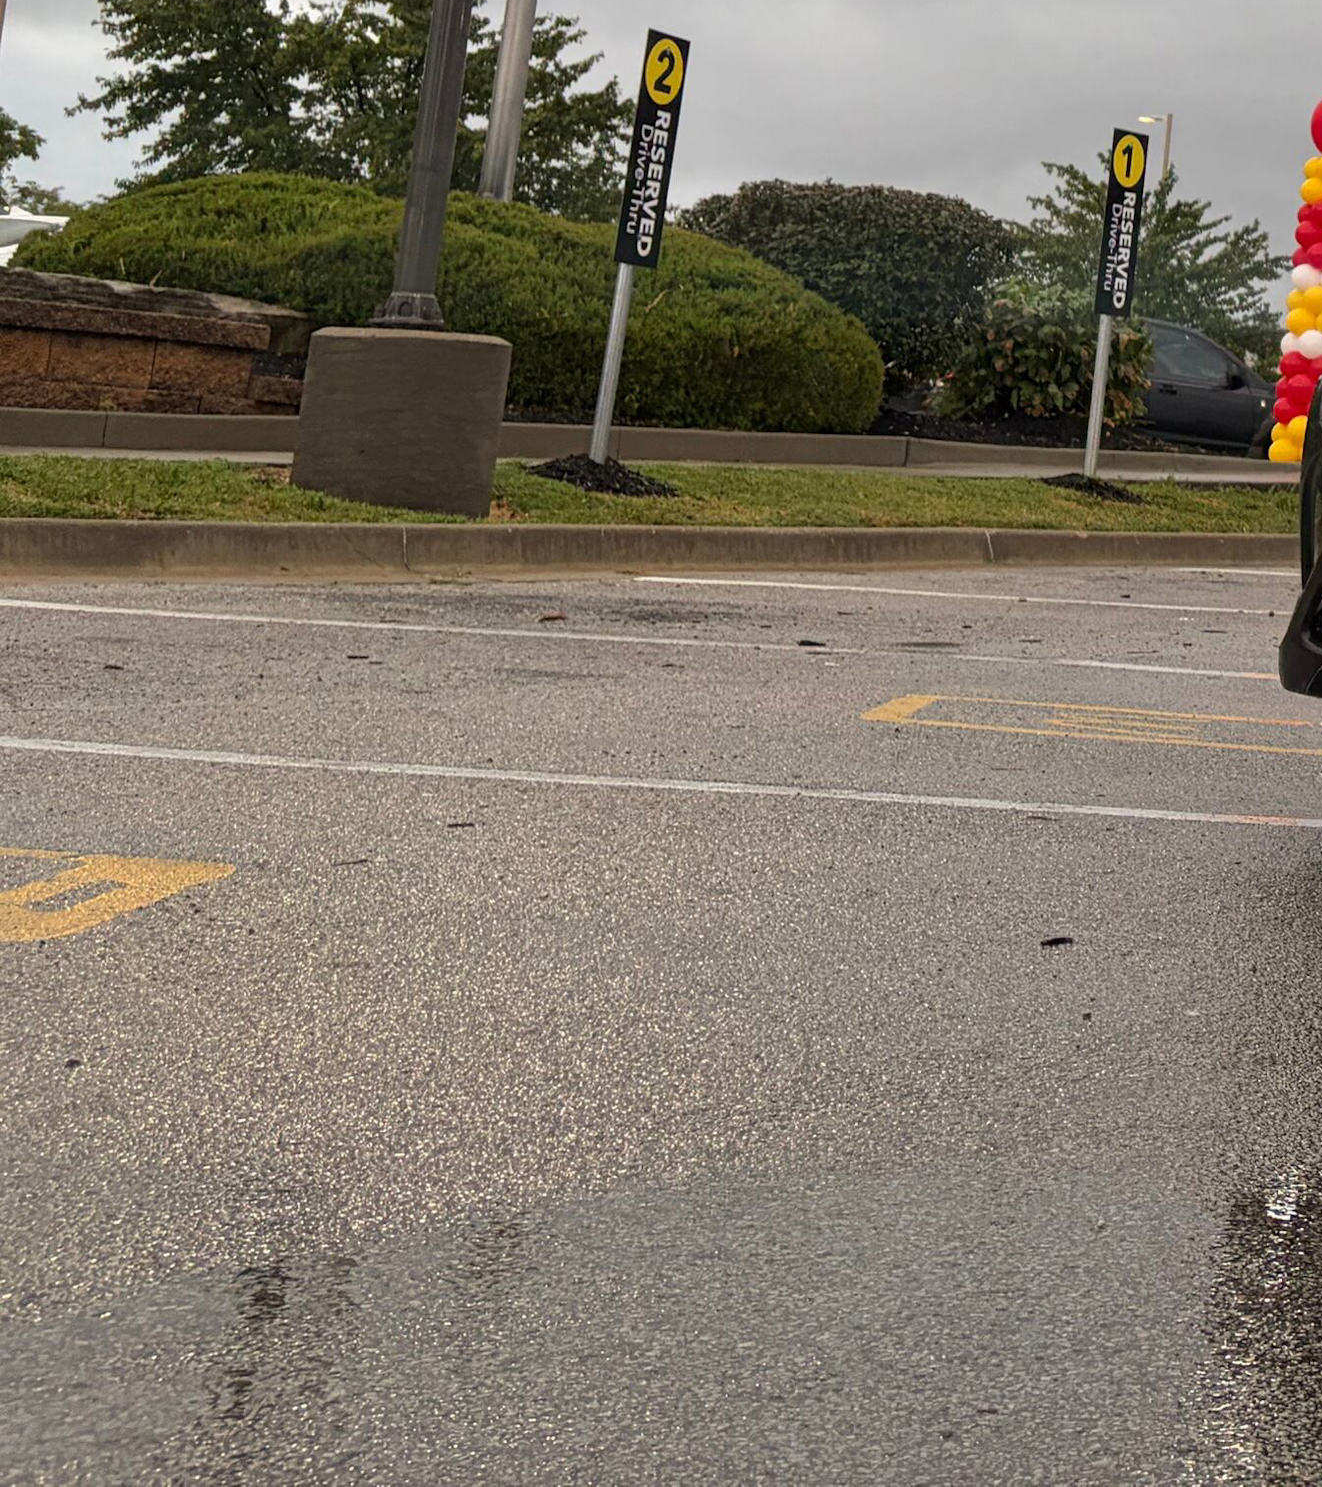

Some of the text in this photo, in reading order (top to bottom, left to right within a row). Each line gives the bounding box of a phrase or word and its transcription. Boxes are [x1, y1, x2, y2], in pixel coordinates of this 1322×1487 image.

[653, 47, 676, 94] 2
[626, 124, 654, 235] Drive-Thru
[636, 109, 672, 258] RESERVED
[1121, 142, 1133, 179] 1
[1103, 203, 1123, 292] Drive-Thru
[1112, 191, 1137, 310] RESERVED
